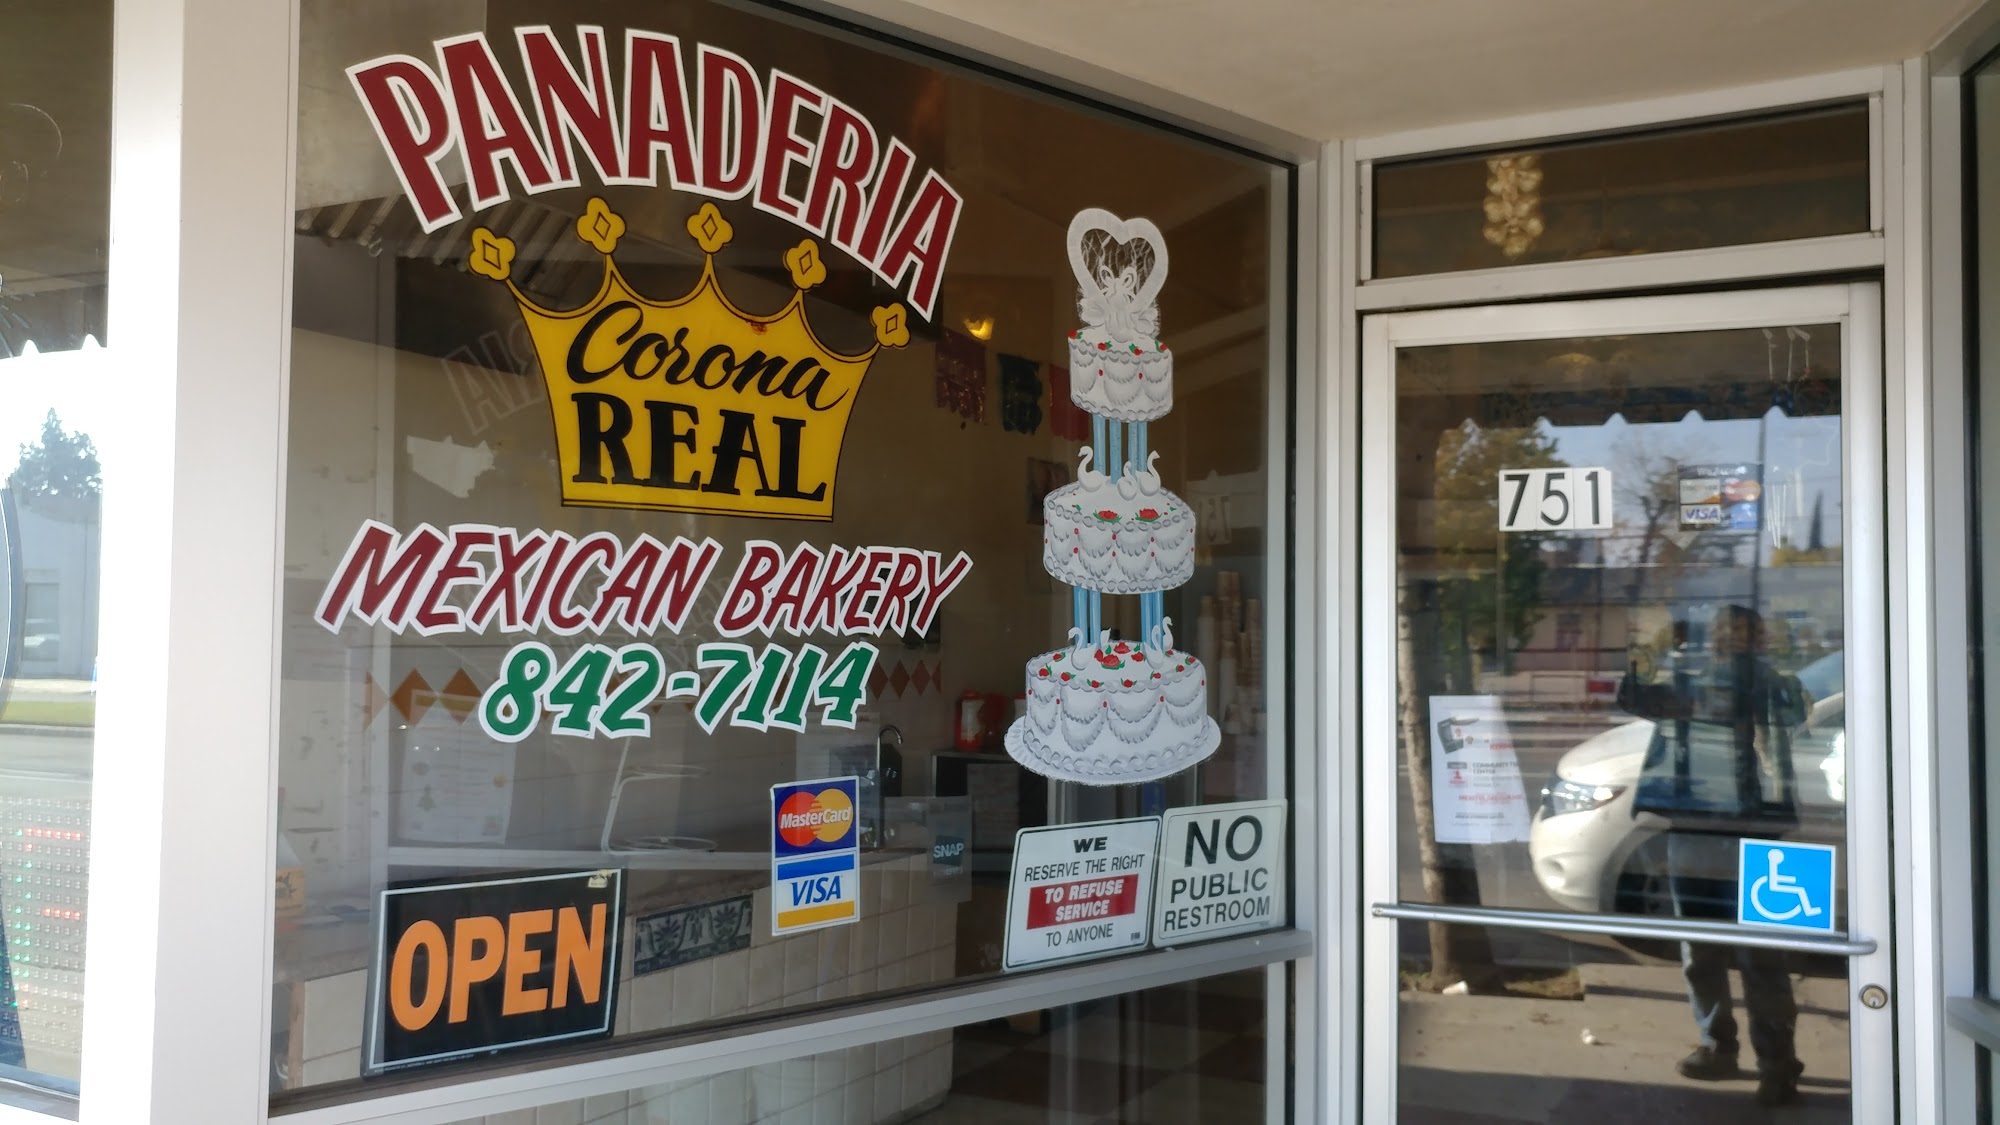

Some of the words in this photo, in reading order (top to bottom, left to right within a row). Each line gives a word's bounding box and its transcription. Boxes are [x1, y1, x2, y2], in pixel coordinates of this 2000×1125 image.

[345, 24, 963, 323] PANADERIA
[566, 302, 850, 411] Corona
[571, 392, 828, 502] REAL
[1504, 470, 1602, 527] 751
[1686, 506, 1719, 520] VISA
[314, 519, 724, 637] MEXICAN
[714, 540, 974, 638] BAKERY
[479, 641, 887, 743] 842-7114
[780, 806, 851, 830] MasterCard
[933, 842, 965, 859] SNAP
[1073, 837, 1108, 853] WE
[1184, 814, 1263, 868] NO
[1024, 861, 1081, 882] RESERVE
[1085, 858, 1107, 874] THE
[1111, 854, 1145, 872] RIGHT
[1170, 867, 1269, 904] PUBLIC
[791, 875, 842, 907] VISA
[1045, 887, 1064, 904] TO
[1069, 879, 1125, 901] REFUSE
[1055, 900, 1110, 922] SERVICE
[1163, 895, 1271, 932] RESTROOM
[1046, 931, 1062, 947] TO
[1066, 923, 1114, 944] ANYONE
[390, 902, 608, 1031] OPEN
